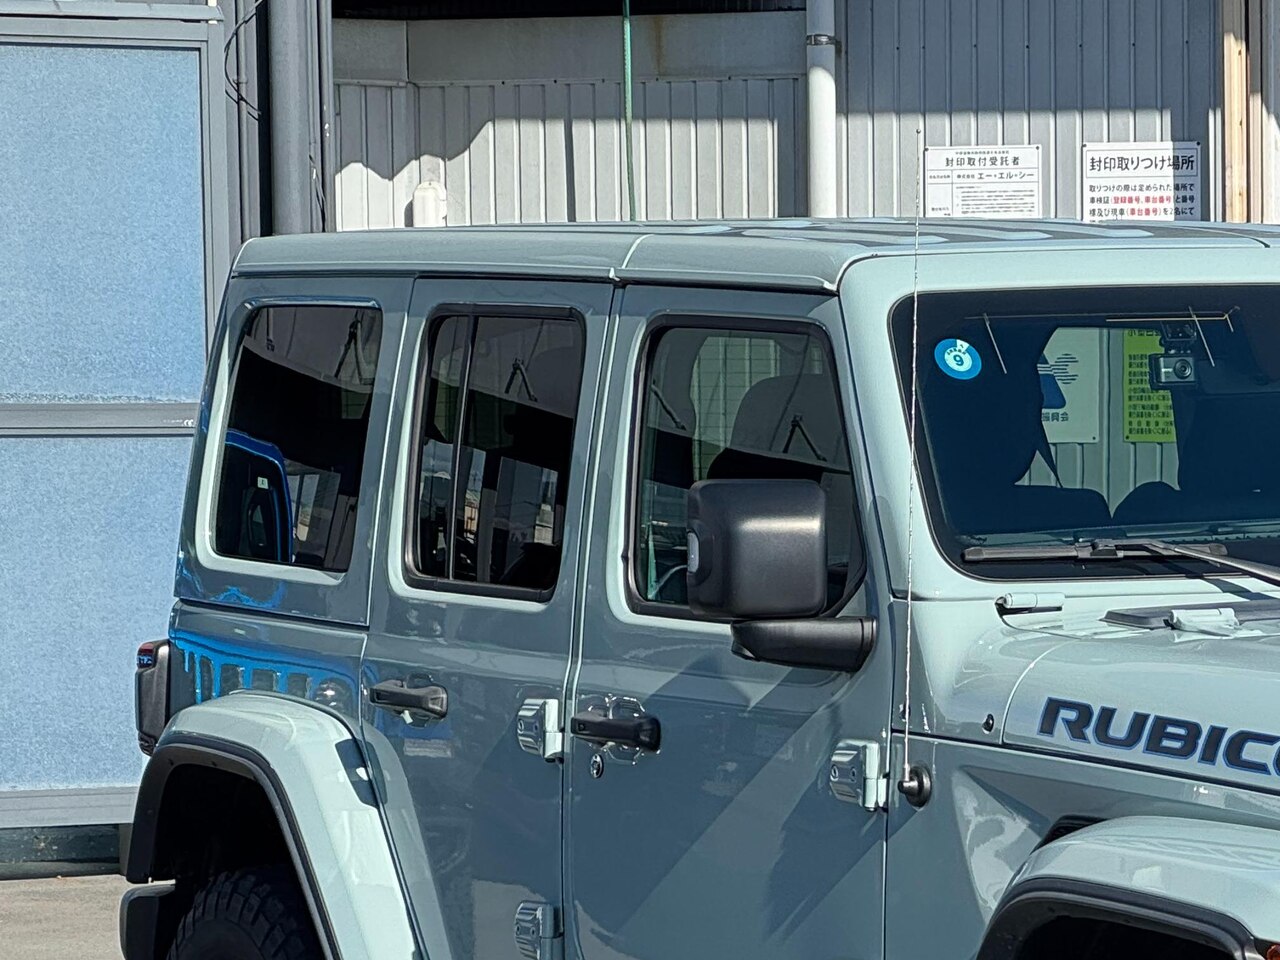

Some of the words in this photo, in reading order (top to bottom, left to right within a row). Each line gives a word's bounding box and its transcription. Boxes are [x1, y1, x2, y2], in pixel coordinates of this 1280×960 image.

[945, 156, 1020, 167] 封印取付受託者
[1089, 155, 1195, 172] 封印取りつけ場所
[953, 354, 964, 366] 9
